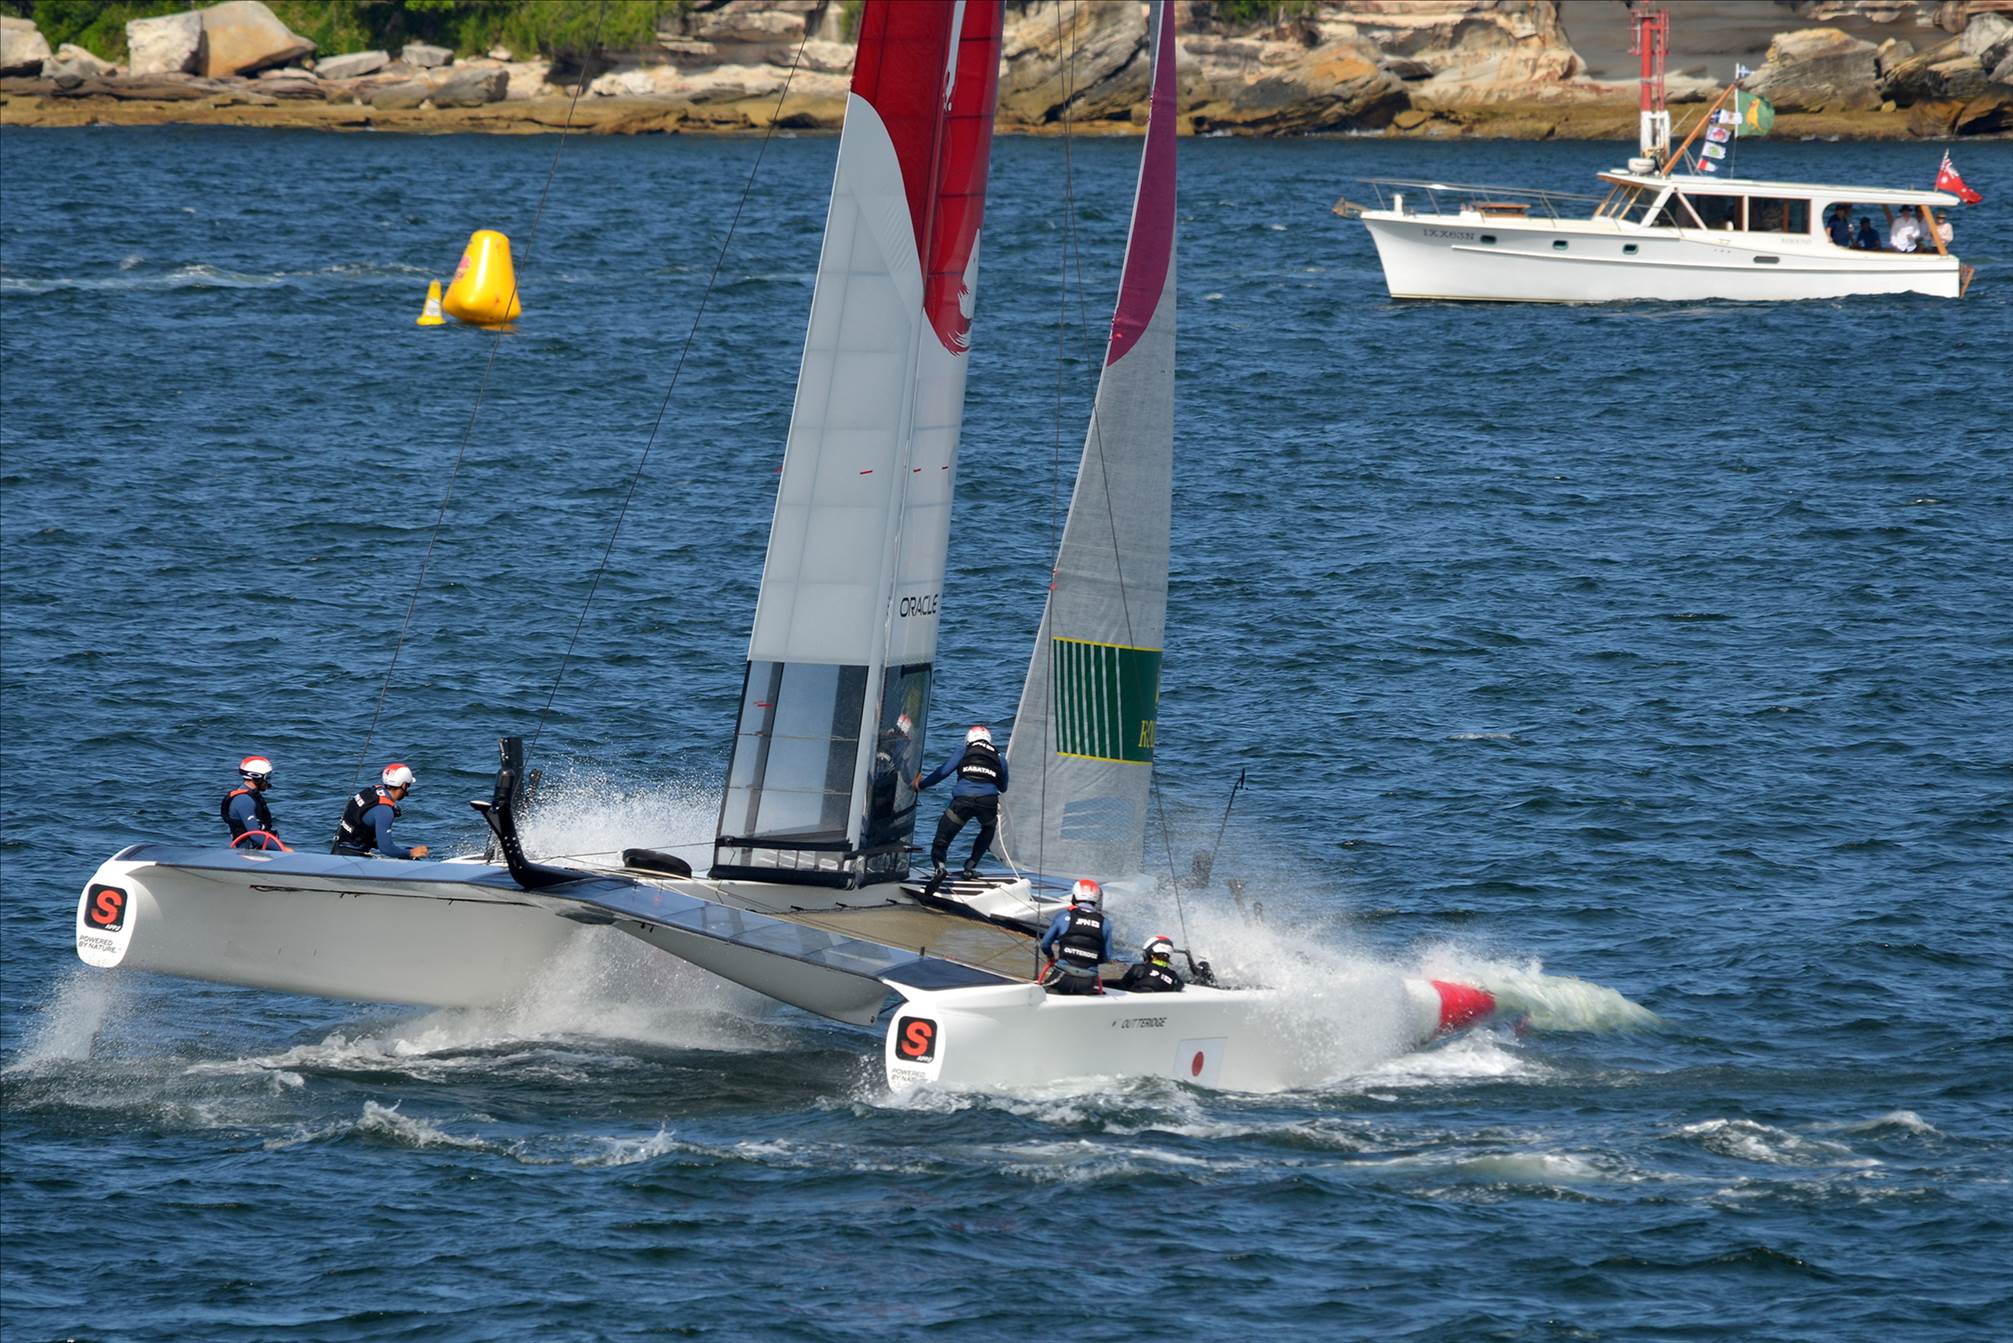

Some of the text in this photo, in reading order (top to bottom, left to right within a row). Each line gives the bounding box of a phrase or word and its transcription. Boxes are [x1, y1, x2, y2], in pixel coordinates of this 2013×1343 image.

[900, 594, 938, 617] ORACLE
[91, 889, 123, 925] S
[79, 934, 113, 946] POWERED
[1121, 1017, 1168, 1029] OUTTERIDGE
[901, 1021, 933, 1057] S
